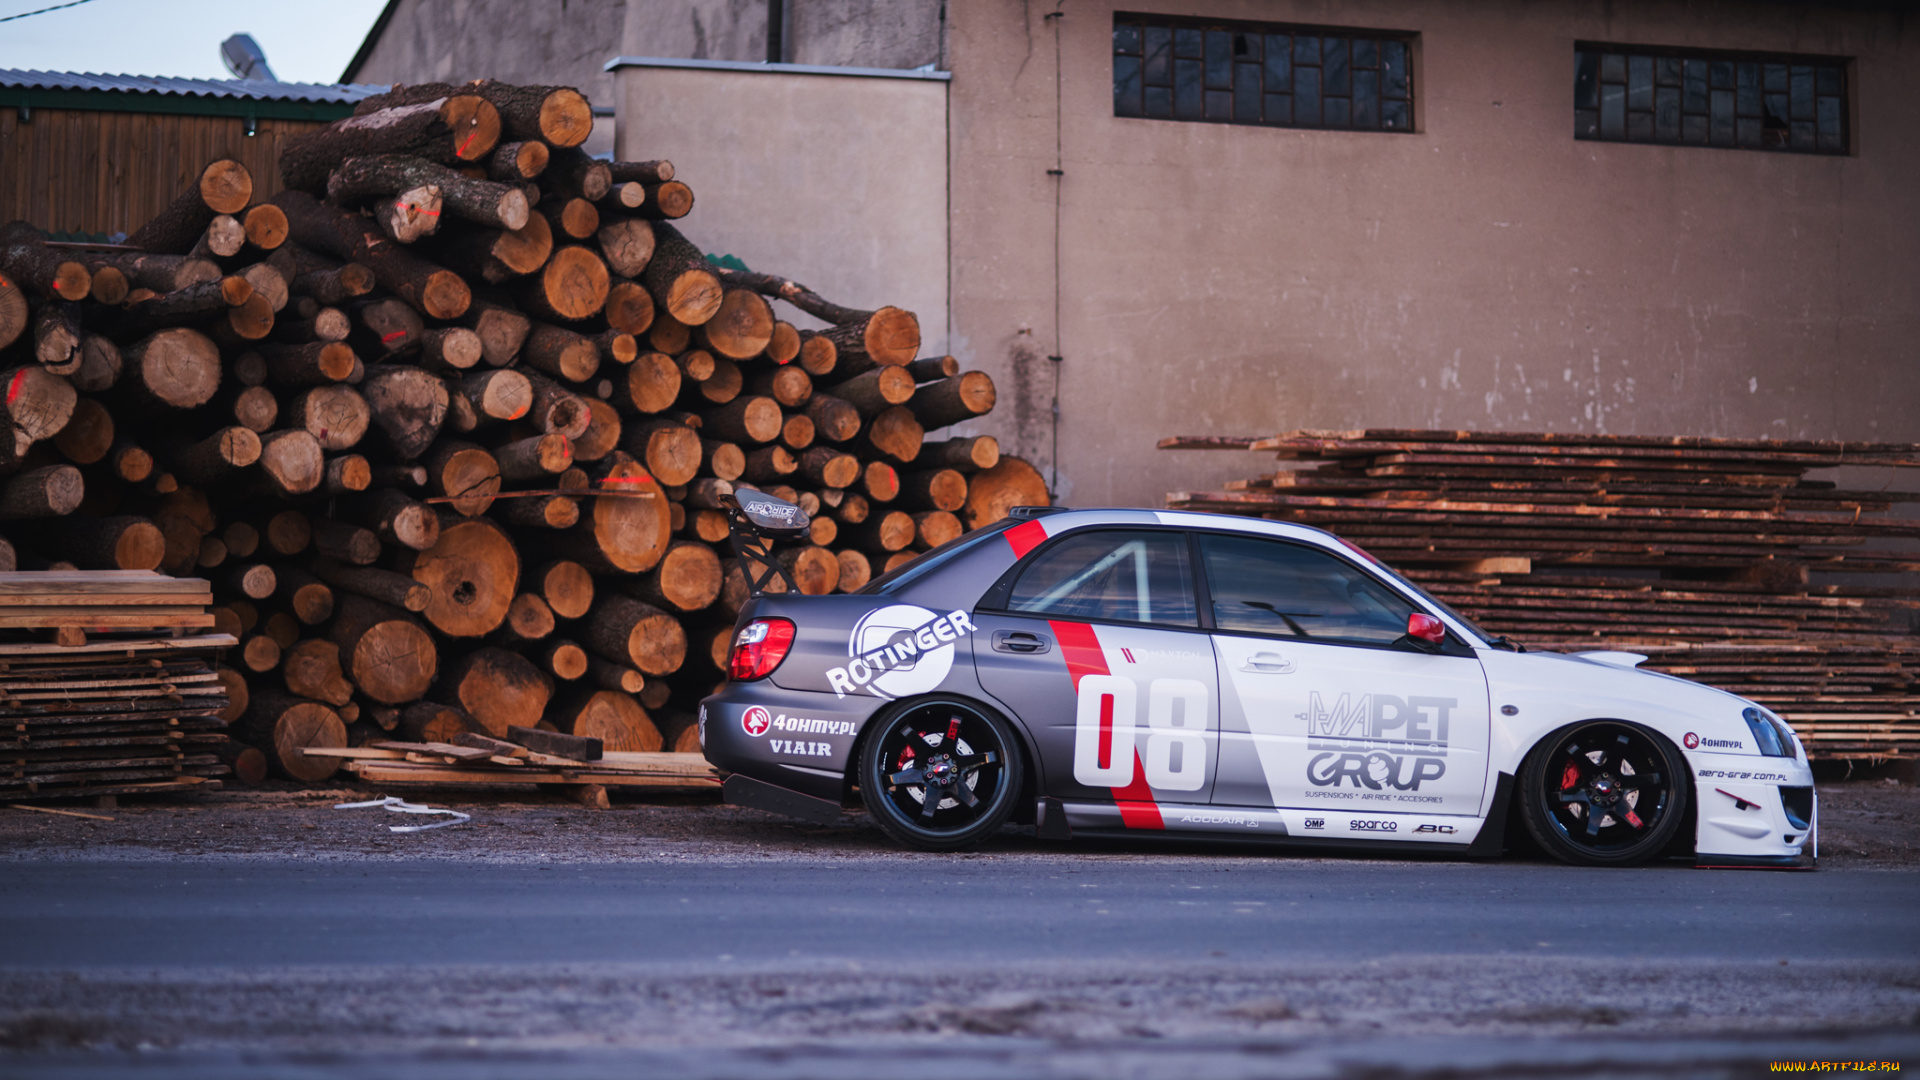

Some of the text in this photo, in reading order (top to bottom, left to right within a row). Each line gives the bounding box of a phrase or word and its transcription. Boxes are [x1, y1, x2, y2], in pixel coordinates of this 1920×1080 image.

[826, 609, 978, 700] ROTINGER
[1150, 649, 1200, 661] MAXTON
[1307, 691, 1458, 741] MAPET
[1073, 674, 1209, 792] 08
[770, 739, 832, 757] VIAIR
[1317, 739, 1440, 753] TUNING
[1307, 752, 1446, 792] GROUP
[1305, 790, 1354, 800] SUSPENSIONS
[1362, 793, 1392, 801] AIR RIDE
[1398, 795, 1443, 804] ACCESORIES
[1181, 815, 1245, 825] ACCUAIR
[1304, 819, 1325, 828] OMP
[1350, 819, 1398, 831] sparco
